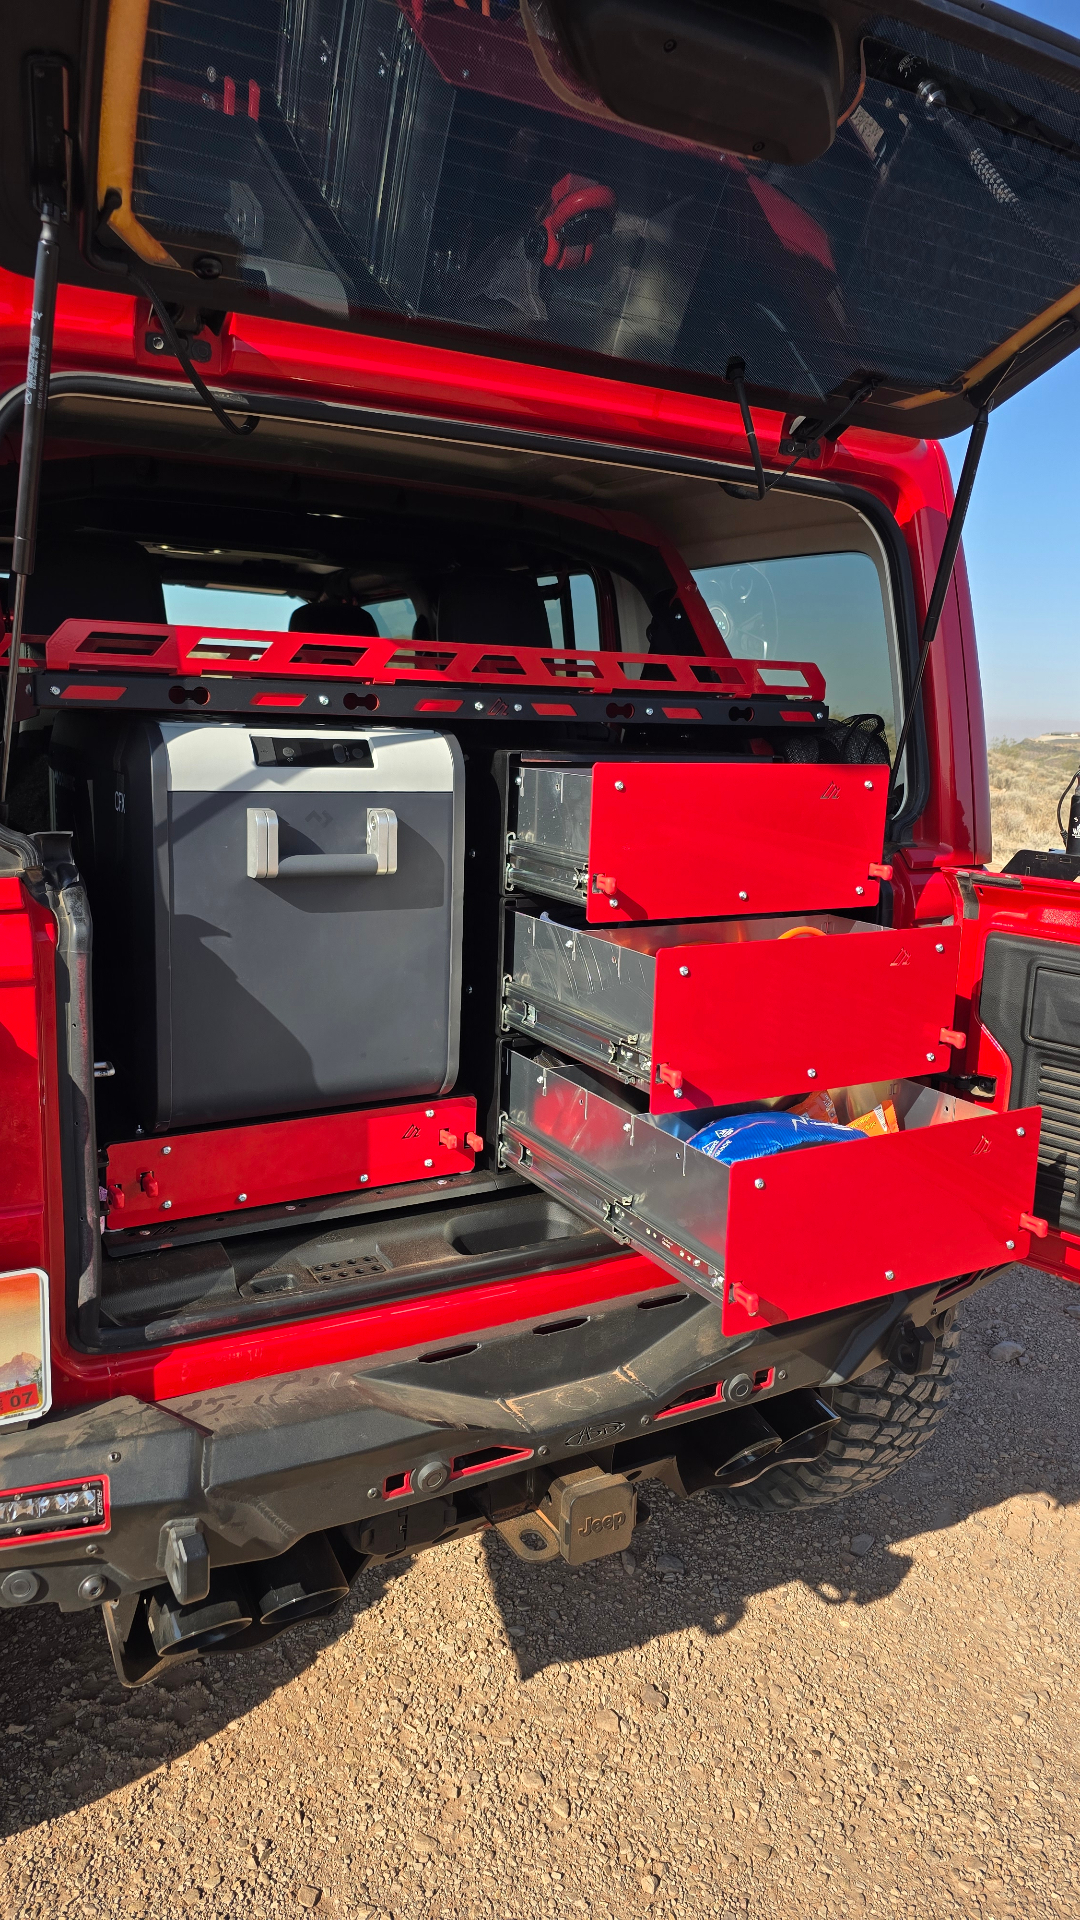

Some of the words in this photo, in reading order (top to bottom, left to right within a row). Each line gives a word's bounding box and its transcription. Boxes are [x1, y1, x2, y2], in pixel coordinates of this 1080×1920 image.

[115, 791, 126, 814] CFX
[10, 1391, 33, 1408] 07
[578, 1511, 626, 1537] Jeep
